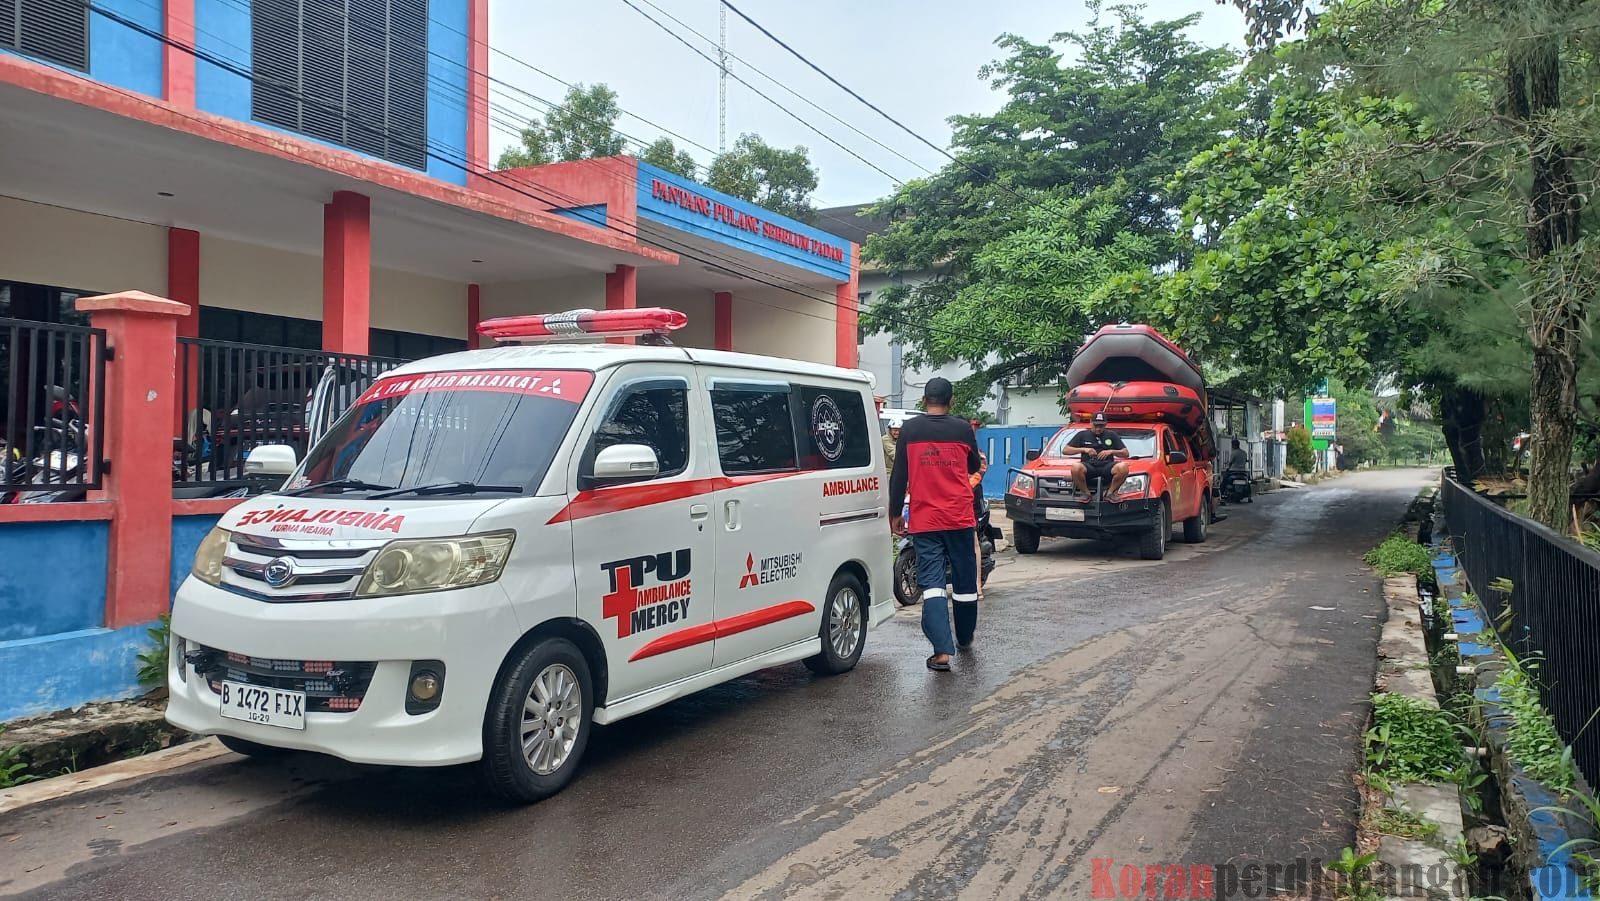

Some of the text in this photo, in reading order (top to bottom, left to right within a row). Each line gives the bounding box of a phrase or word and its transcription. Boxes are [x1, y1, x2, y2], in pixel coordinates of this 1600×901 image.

[652, 178, 844, 262] PANTANG PULANG SEBELUM PADAM
[384, 374, 541, 395] TIM KURIR MALAIKAT
[823, 477, 879, 497] AMBULANCE
[600, 548, 692, 593] TPU
[760, 552, 803, 571] MITSUBISHI
[760, 565, 797, 585] ELECTRIC
[636, 579, 691, 608] AMBULANCE
[631, 597, 690, 635] MERCY
[222, 683, 302, 717] B 1472 FIX
